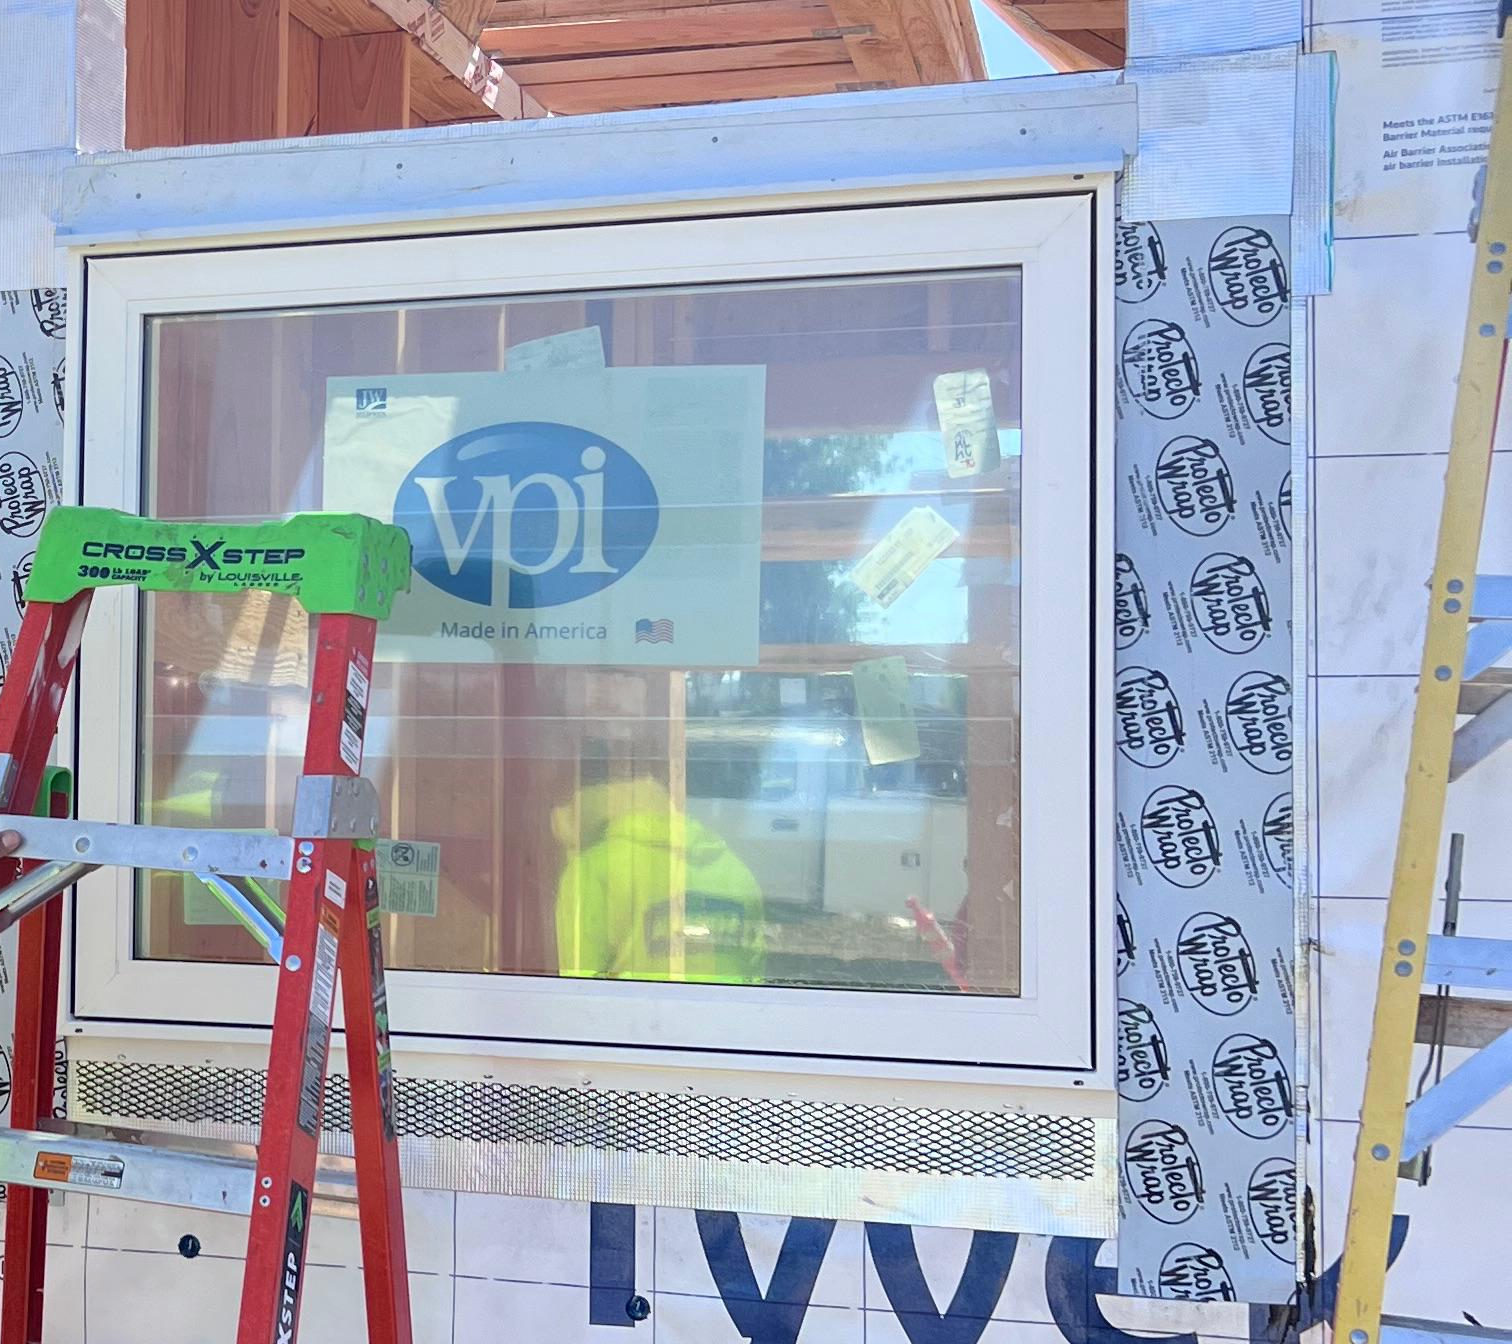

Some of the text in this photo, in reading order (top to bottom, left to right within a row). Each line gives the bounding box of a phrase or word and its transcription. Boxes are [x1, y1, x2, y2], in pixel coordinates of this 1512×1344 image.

[1439, 143, 1490, 154] Associati
[1437, 155, 1488, 167] installati
[414, 446, 620, 609] vpi
[77, 564, 111, 580] 300
[217, 572, 303, 582] LOUISVILLE
[441, 619, 607, 641] Made in America
